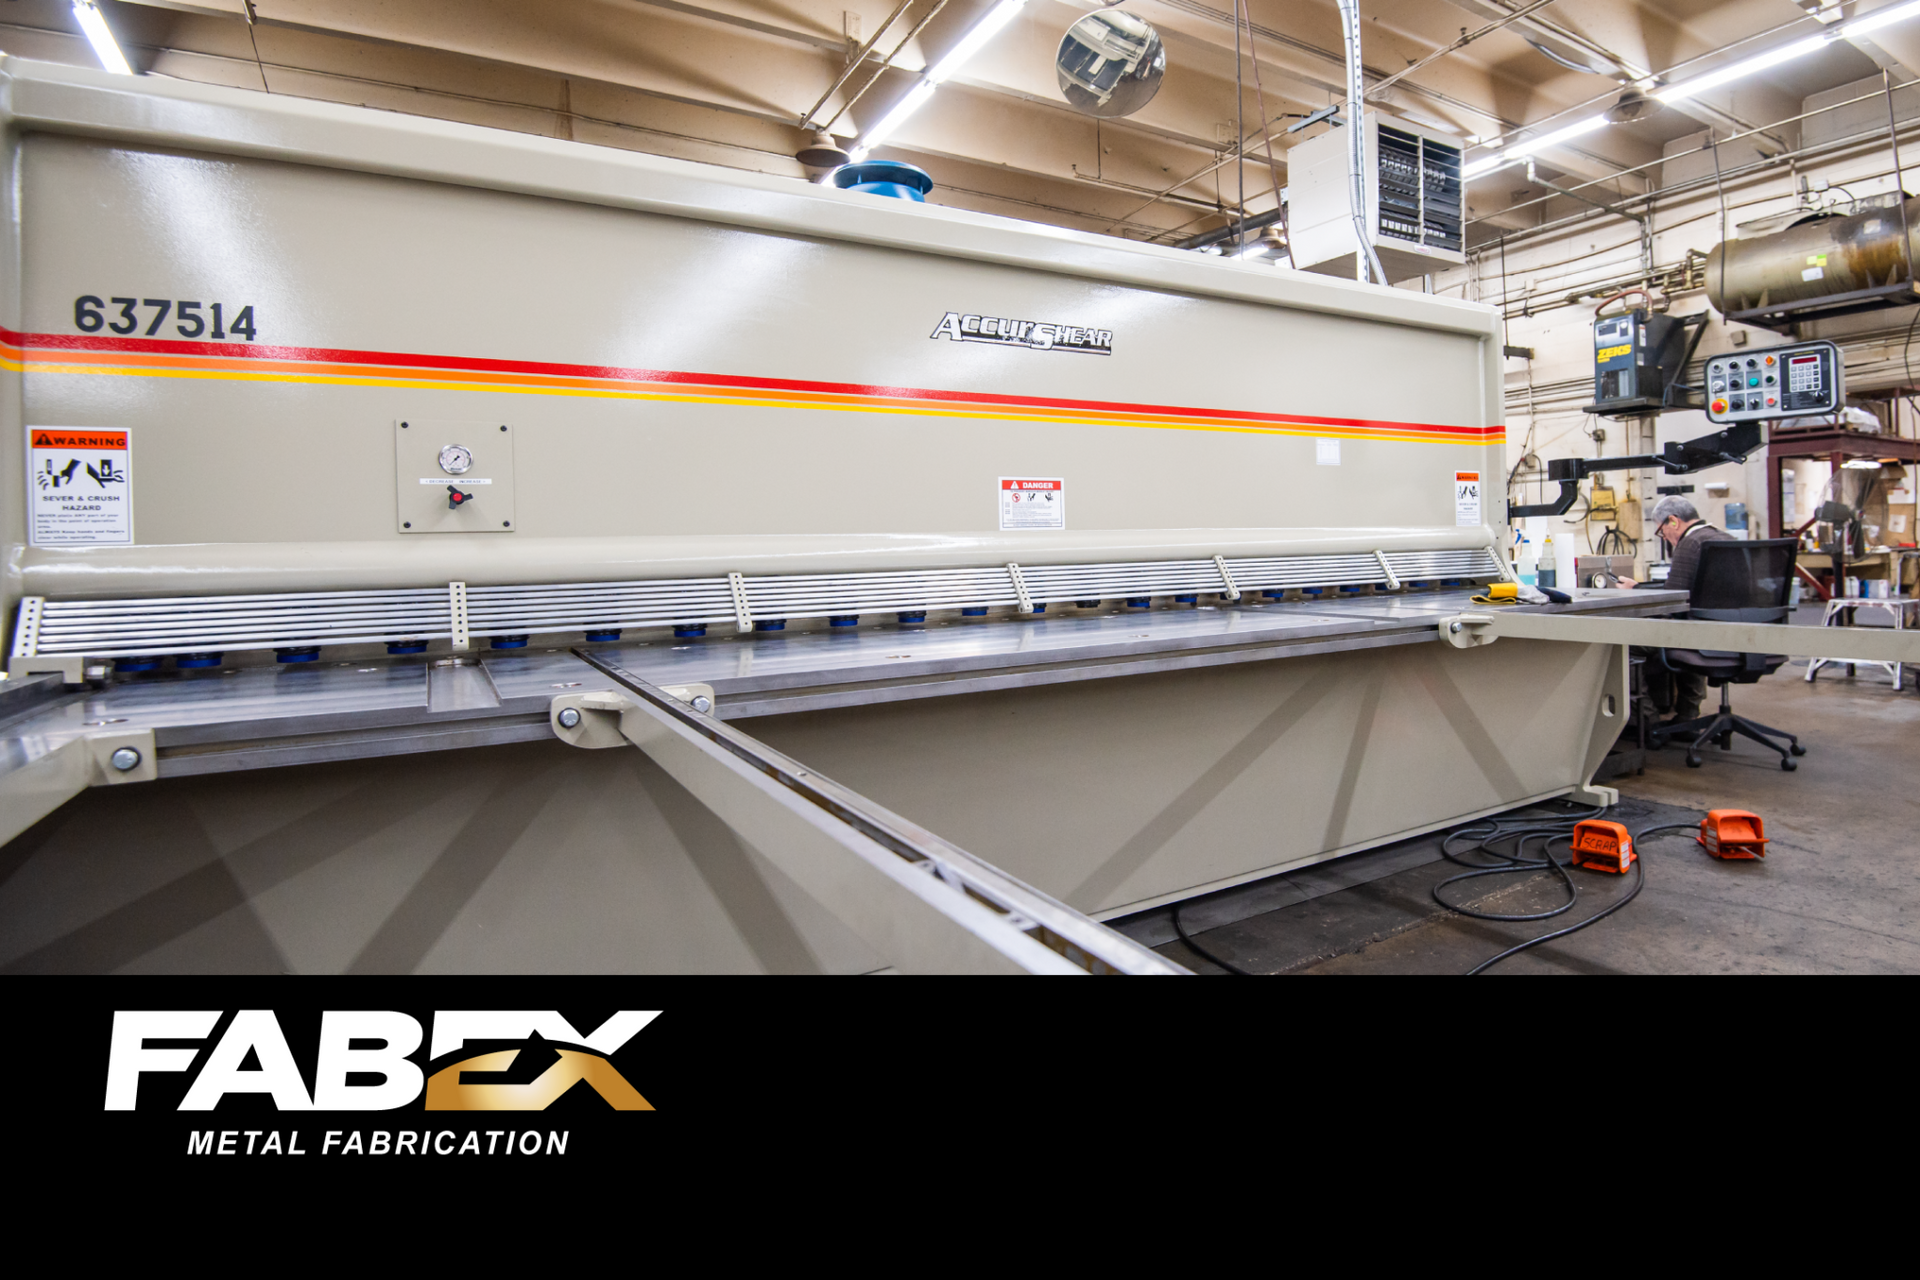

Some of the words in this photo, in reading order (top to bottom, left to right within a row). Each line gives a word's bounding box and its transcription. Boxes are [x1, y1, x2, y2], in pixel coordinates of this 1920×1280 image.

[74, 295, 257, 341] 637514
[53, 437, 126, 446] WARNING
[1582, 837, 1617, 851] SCRAP
